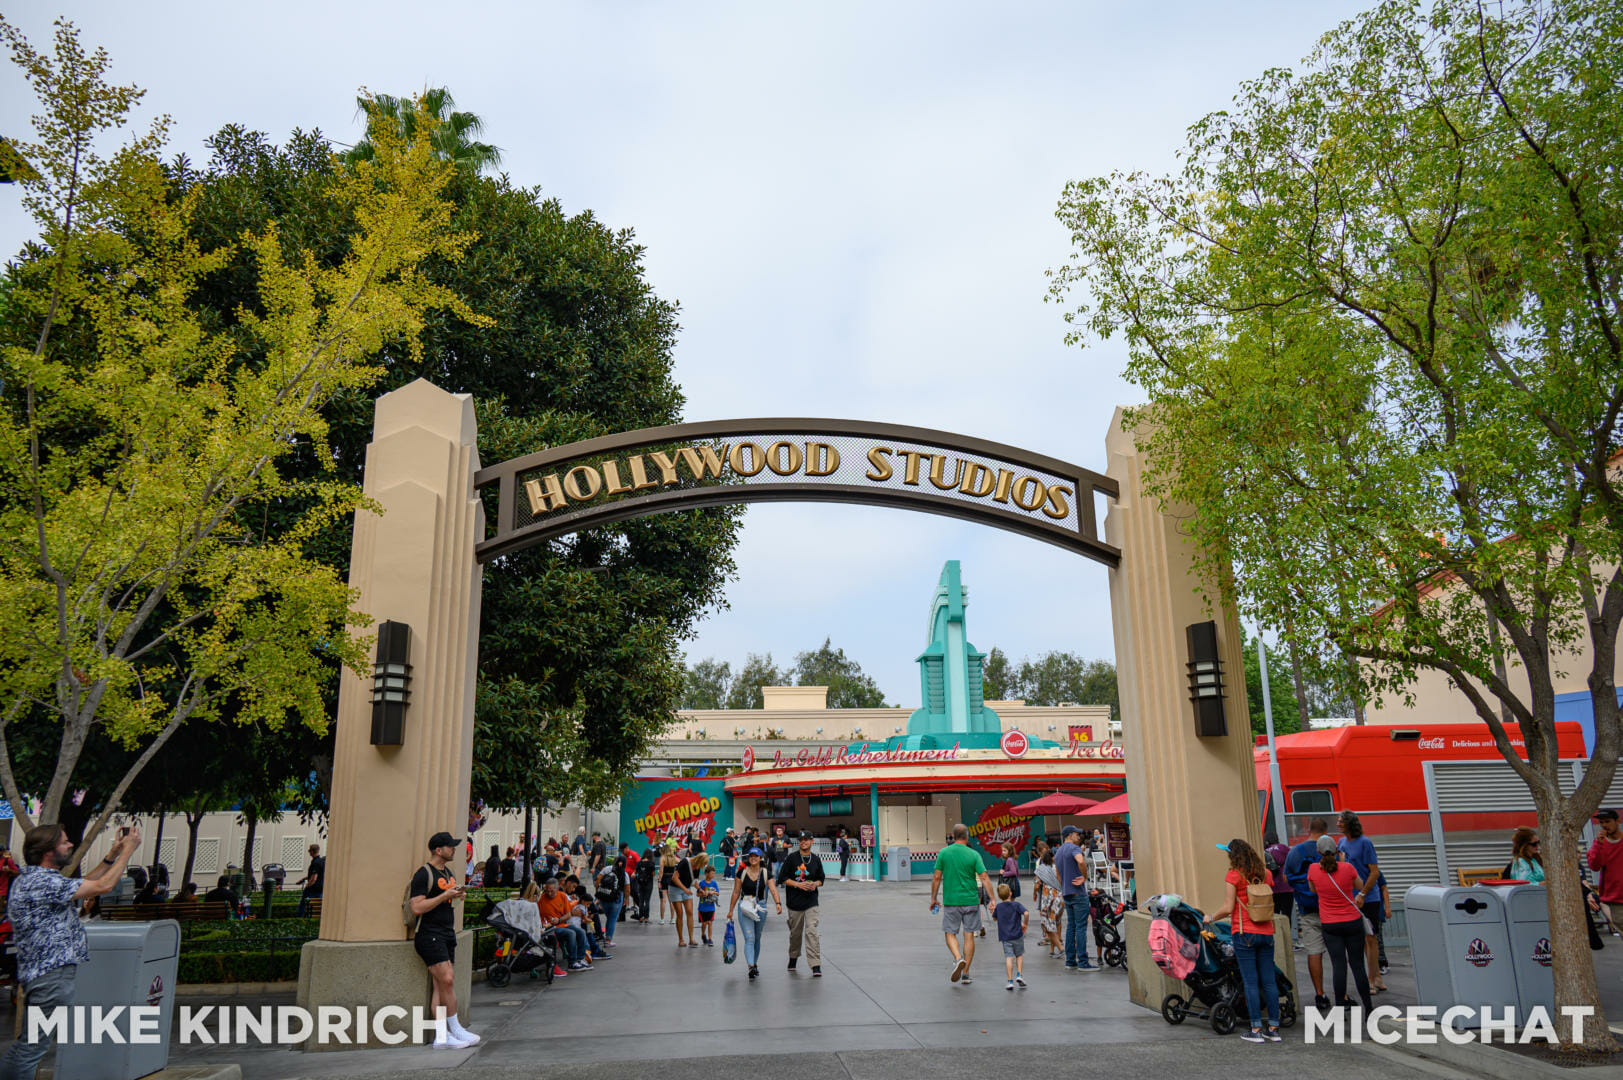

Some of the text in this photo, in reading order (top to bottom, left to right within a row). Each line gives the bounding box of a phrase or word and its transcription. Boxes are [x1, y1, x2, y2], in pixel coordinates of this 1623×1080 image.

[523, 440, 1073, 519] HOLLYWOOD STUDIOS
[1073, 732, 1089, 742] 16
[1418, 737, 1445, 749] Coca-Cola
[1452, 740, 1480, 748] Delicious
[773, 741, 960, 768] Ice Cold Refreshment
[1066, 739, 1125, 758] Ice Col
[635, 797, 721, 833] HOLLYWOOD
[986, 824, 1026, 846] Lounge
